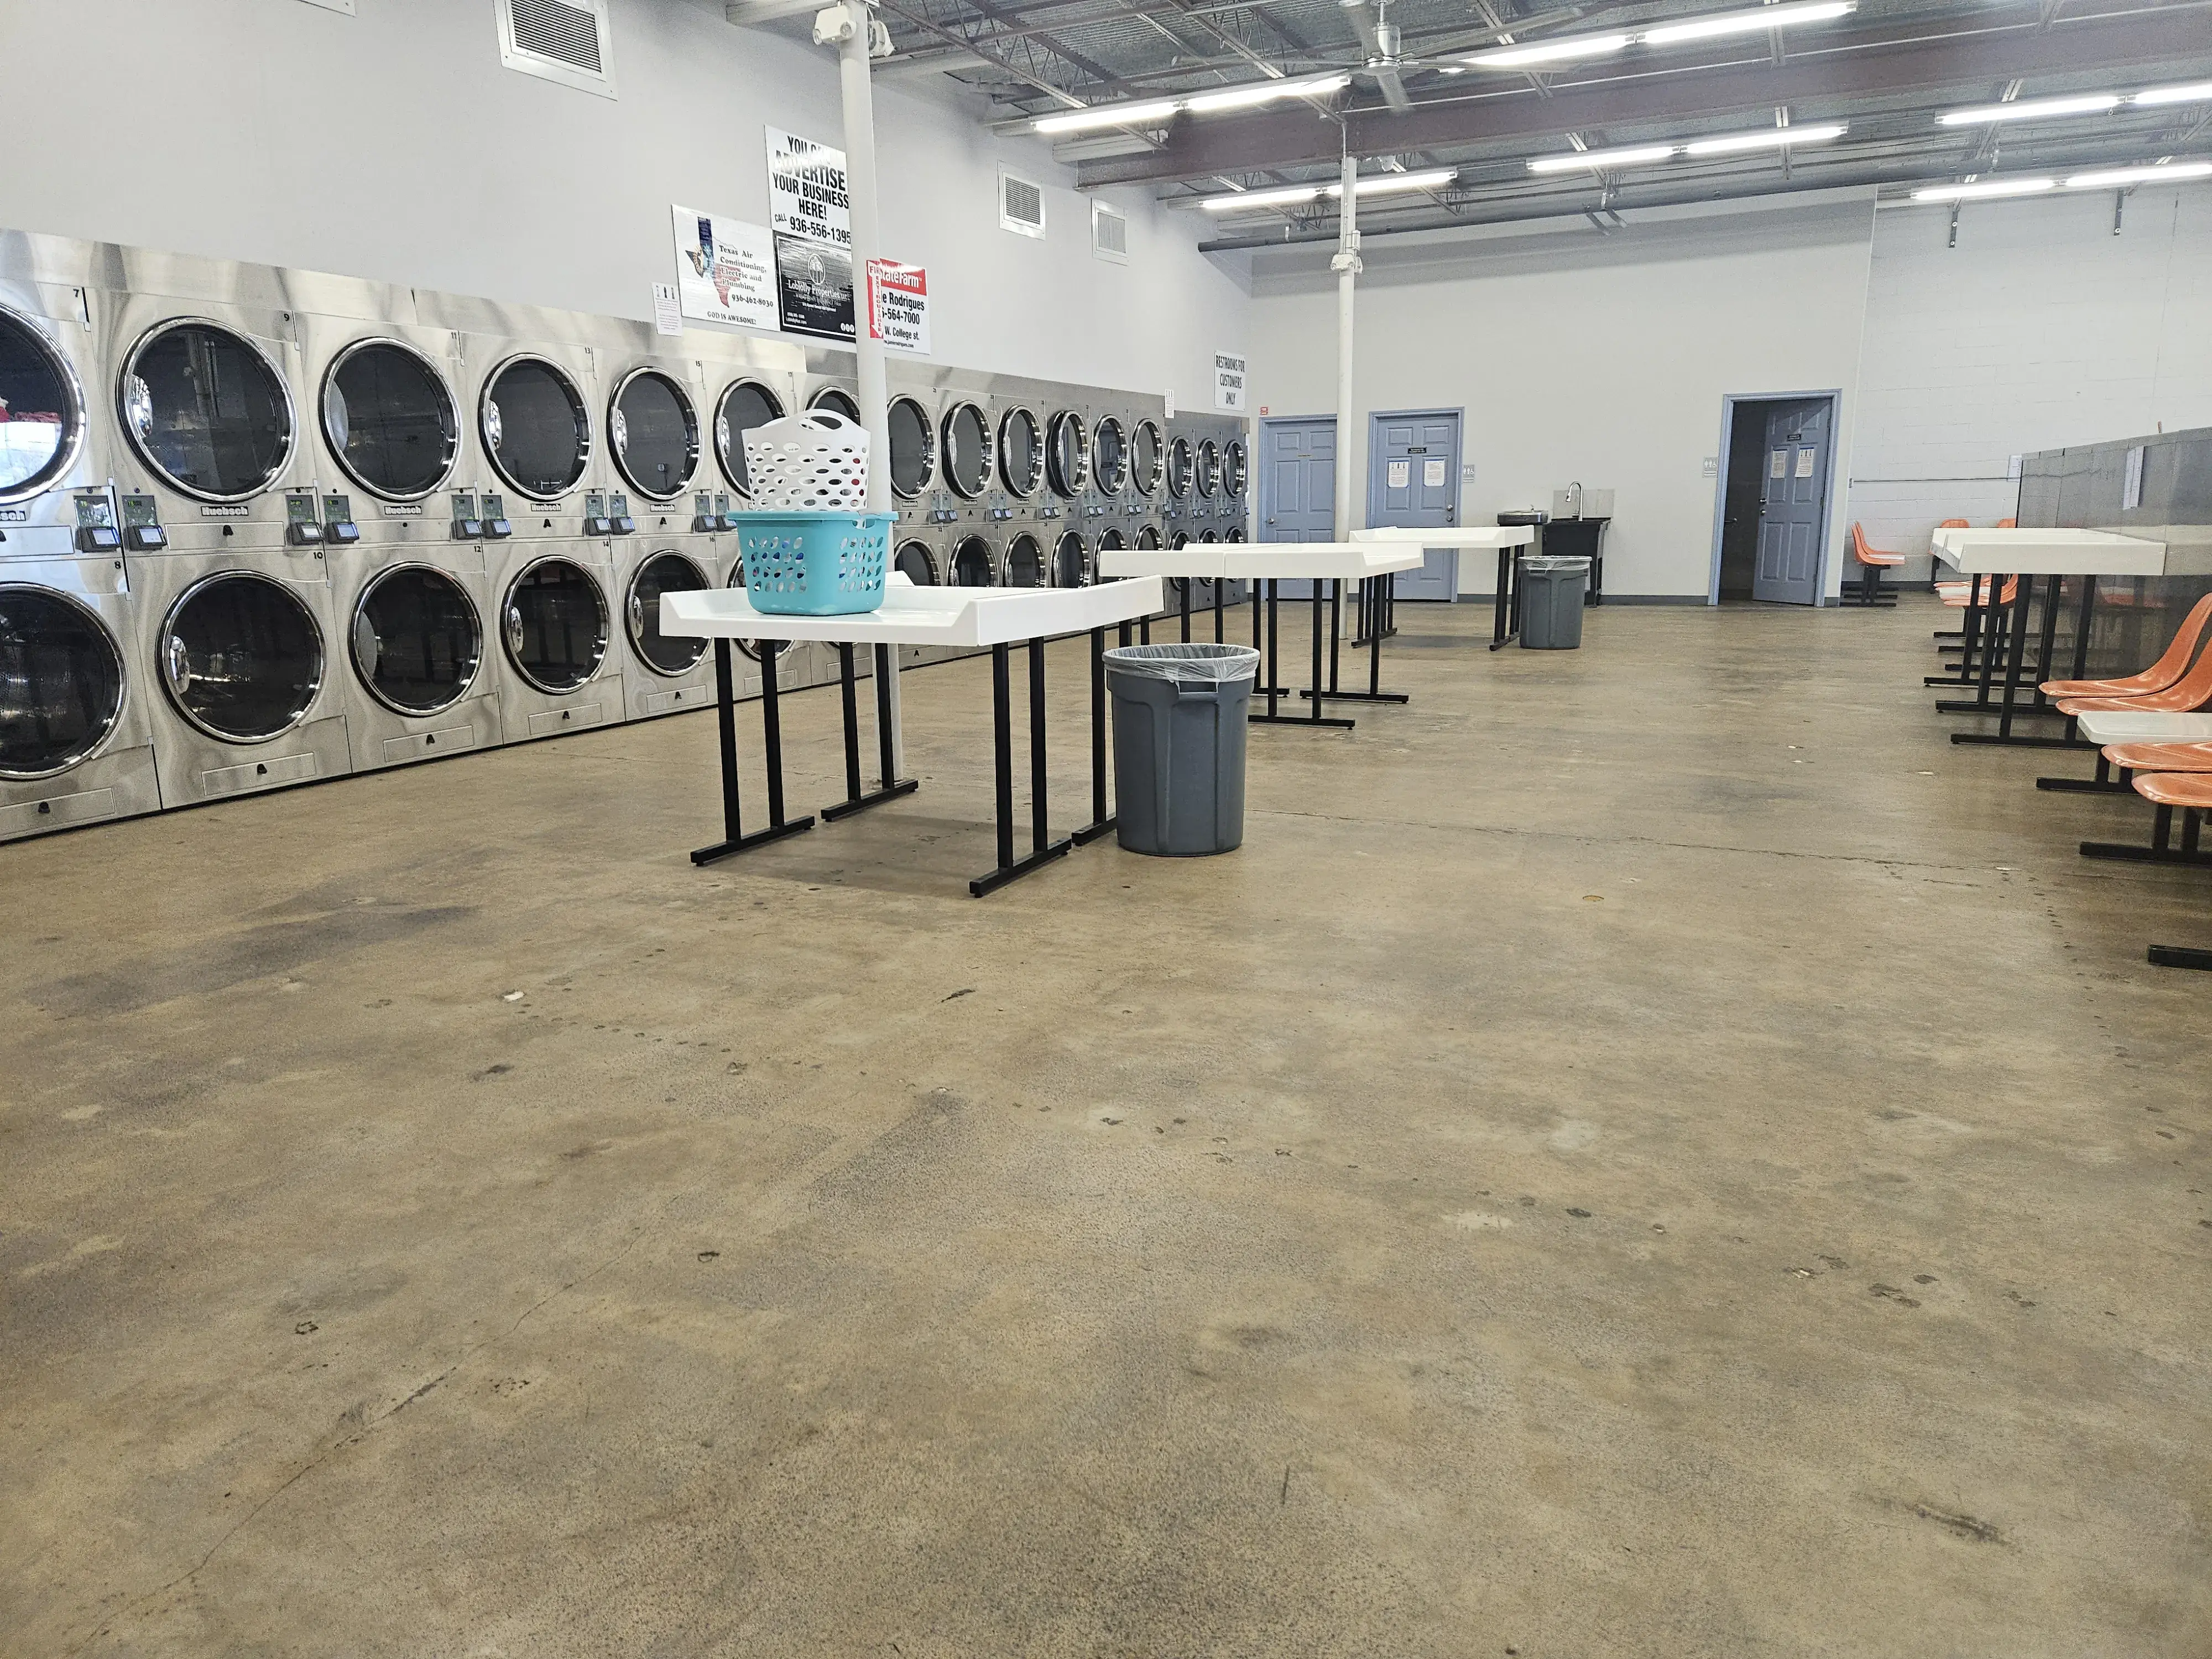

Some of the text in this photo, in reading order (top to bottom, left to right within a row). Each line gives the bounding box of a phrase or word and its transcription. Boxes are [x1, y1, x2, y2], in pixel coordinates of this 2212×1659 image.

[787, 135, 807, 155] YOU
[774, 149, 846, 191] ADVERTISE
[773, 172, 849, 209] YOUR BUSINESS
[799, 198, 827, 221] HERE!
[774, 213, 851, 244] CALL 936-556-1395
[718, 245, 753, 259] Texas Air
[720, 256, 766, 273] Conditioning,
[869, 266, 880, 275] FIR
[721, 267, 748, 279] Electric
[722, 278, 755, 292] Plumbing
[788, 279, 811, 294] Loblolly
[812, 284, 841, 299] Properties
[73, 289, 79, 298] 7
[732, 294, 774, 307] 936-462-8030
[889, 291, 925, 311] Rodrigues
[284, 313, 290, 321] 9
[728, 314, 757, 325] AWESOME!
[884, 325, 891, 336] W.
[893, 327, 912, 340] College
[1215, 354, 1238, 371] RESTROOMS
[1219, 373, 1242, 389] CUSTOMERS
[1225, 392, 1236, 405] ONLY
[201, 506, 248, 516] Huebsch
[384, 505, 422, 515] Huebsch
[313, 551, 323, 560] 10
[114, 561, 121, 569] 8
